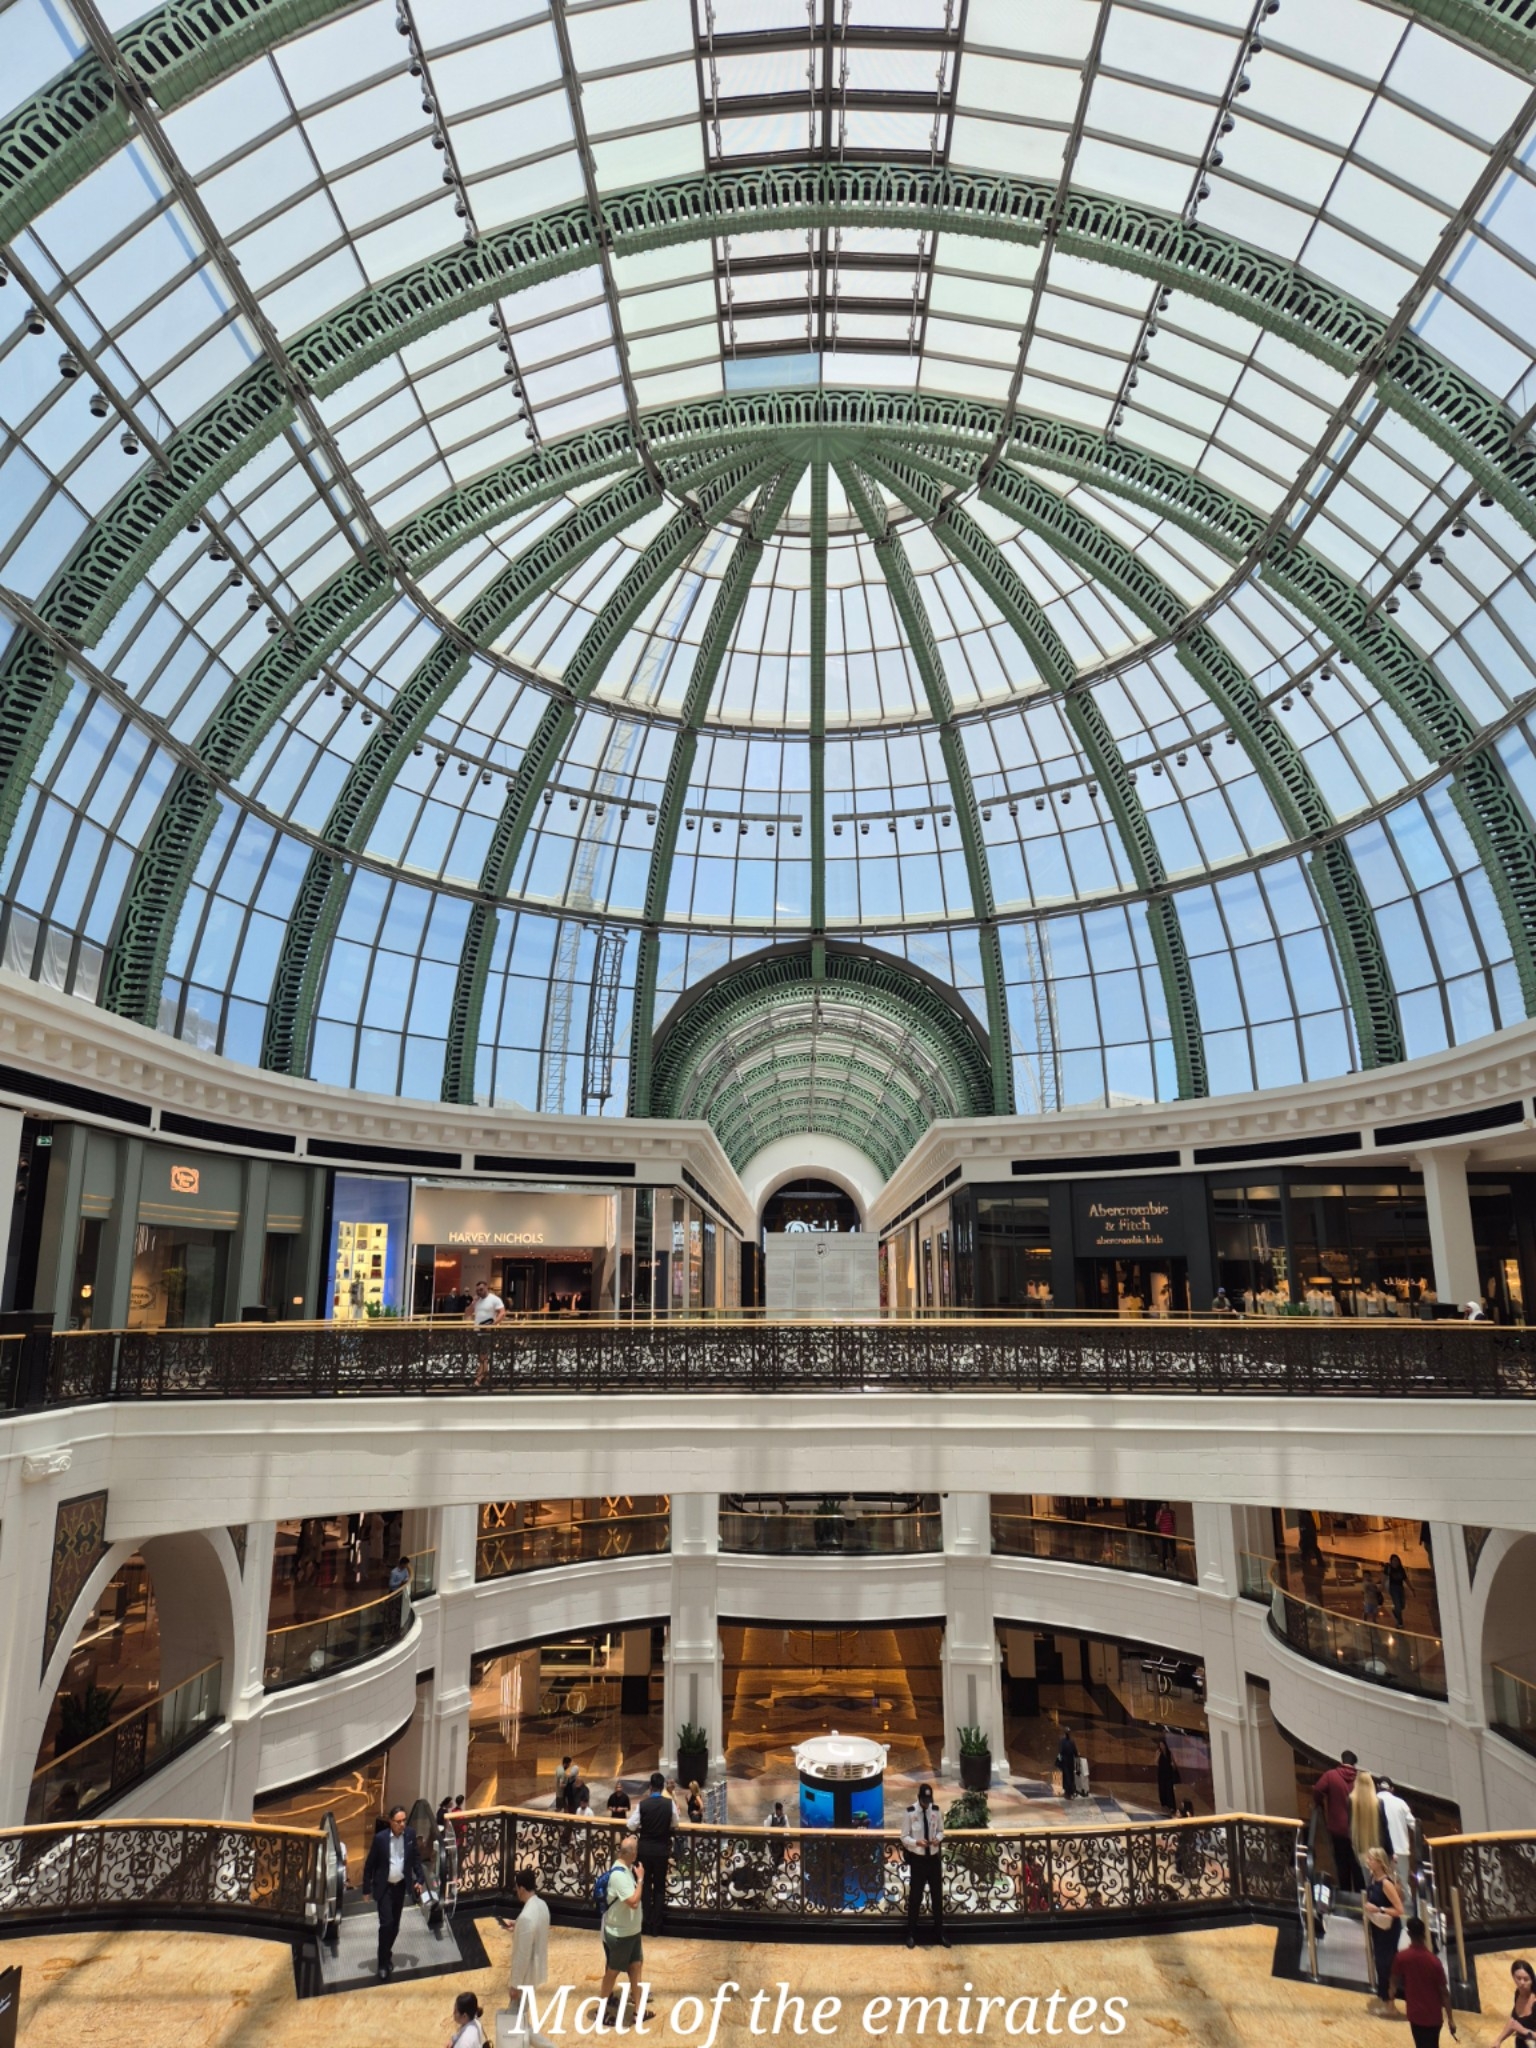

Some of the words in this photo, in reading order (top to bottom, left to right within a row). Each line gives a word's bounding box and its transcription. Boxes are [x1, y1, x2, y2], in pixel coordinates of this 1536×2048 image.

[1089, 1201, 1169, 1217] Abercrombie
[1105, 1222, 1115, 1231] &
[1119, 1217, 1151, 1231] Fitch
[448, 1231, 491, 1243] HARVEY
[494, 1232, 544, 1244] NICHOLS
